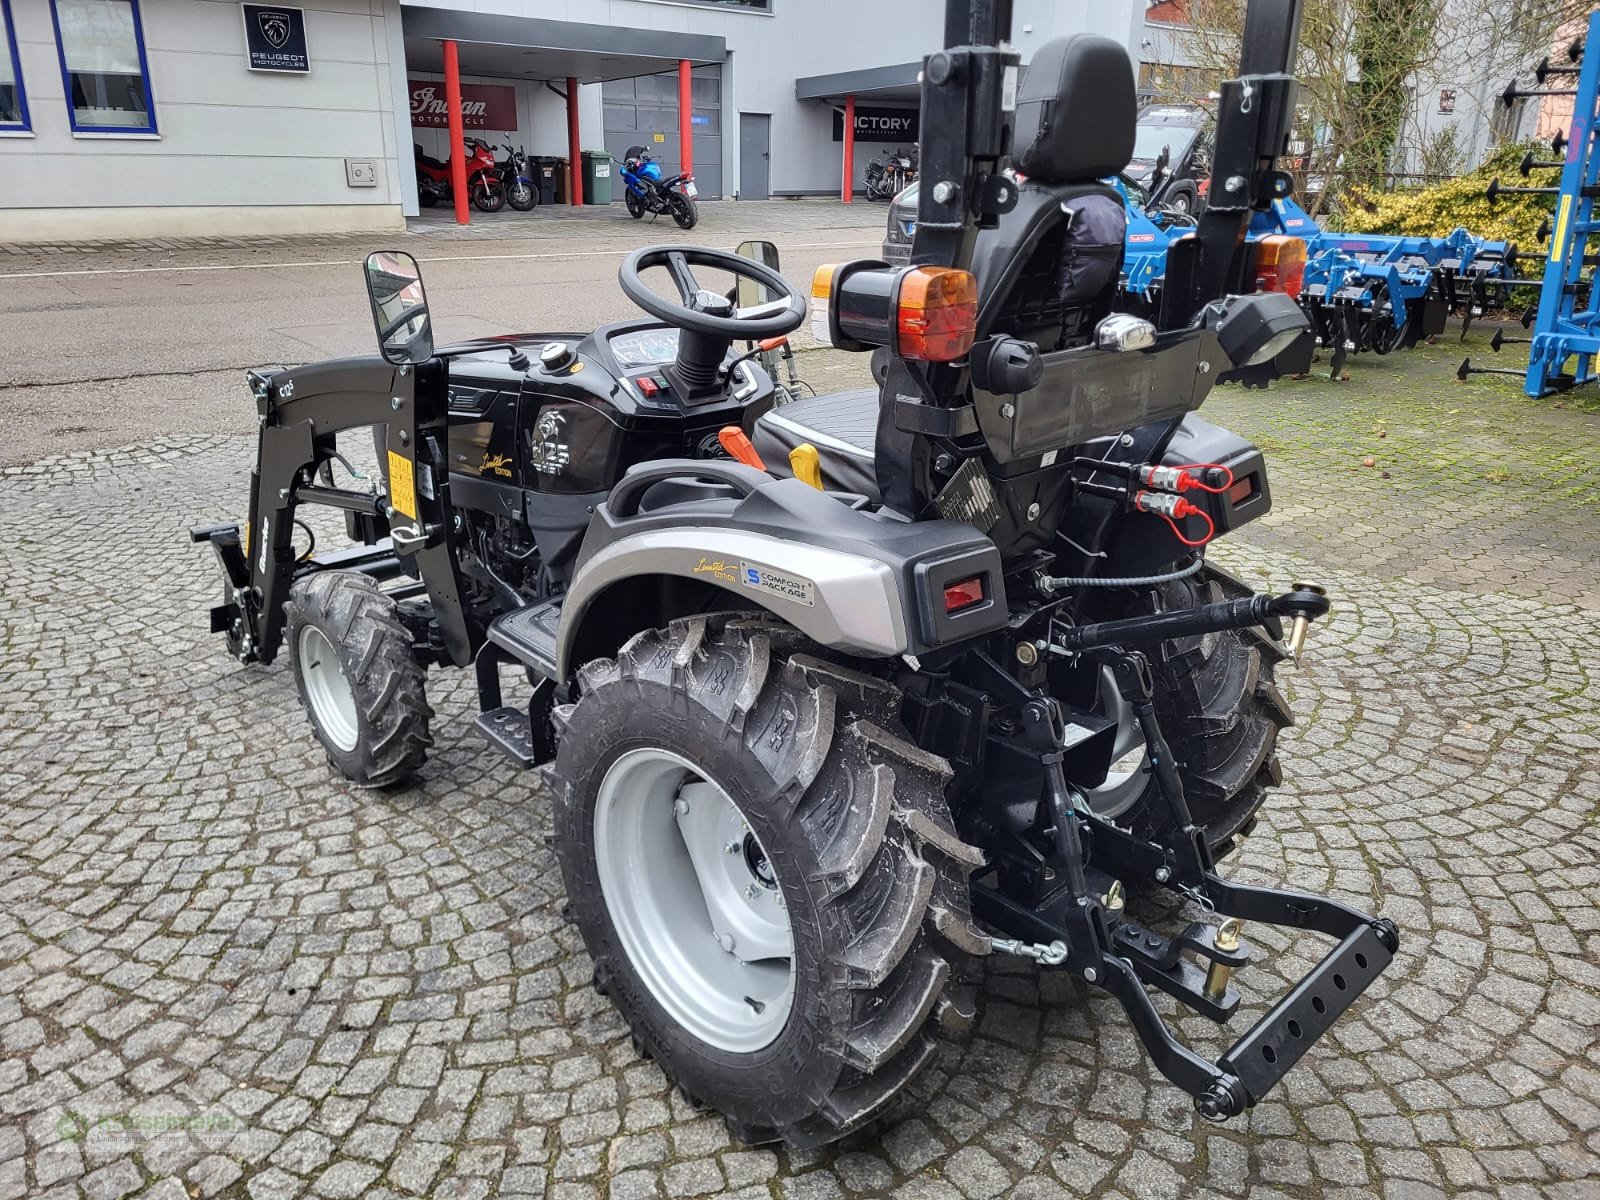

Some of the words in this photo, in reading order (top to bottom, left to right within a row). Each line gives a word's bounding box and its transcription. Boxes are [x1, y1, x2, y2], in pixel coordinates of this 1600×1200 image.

[251, 52, 305, 61] PEUGEOT
[842, 116, 911, 130] ICTORY
[714, 571, 736, 583] EDITION
[747, 568, 760, 584] S
[761, 572, 806, 591] COMFORT
[762, 580, 807, 599] PACKAGE
